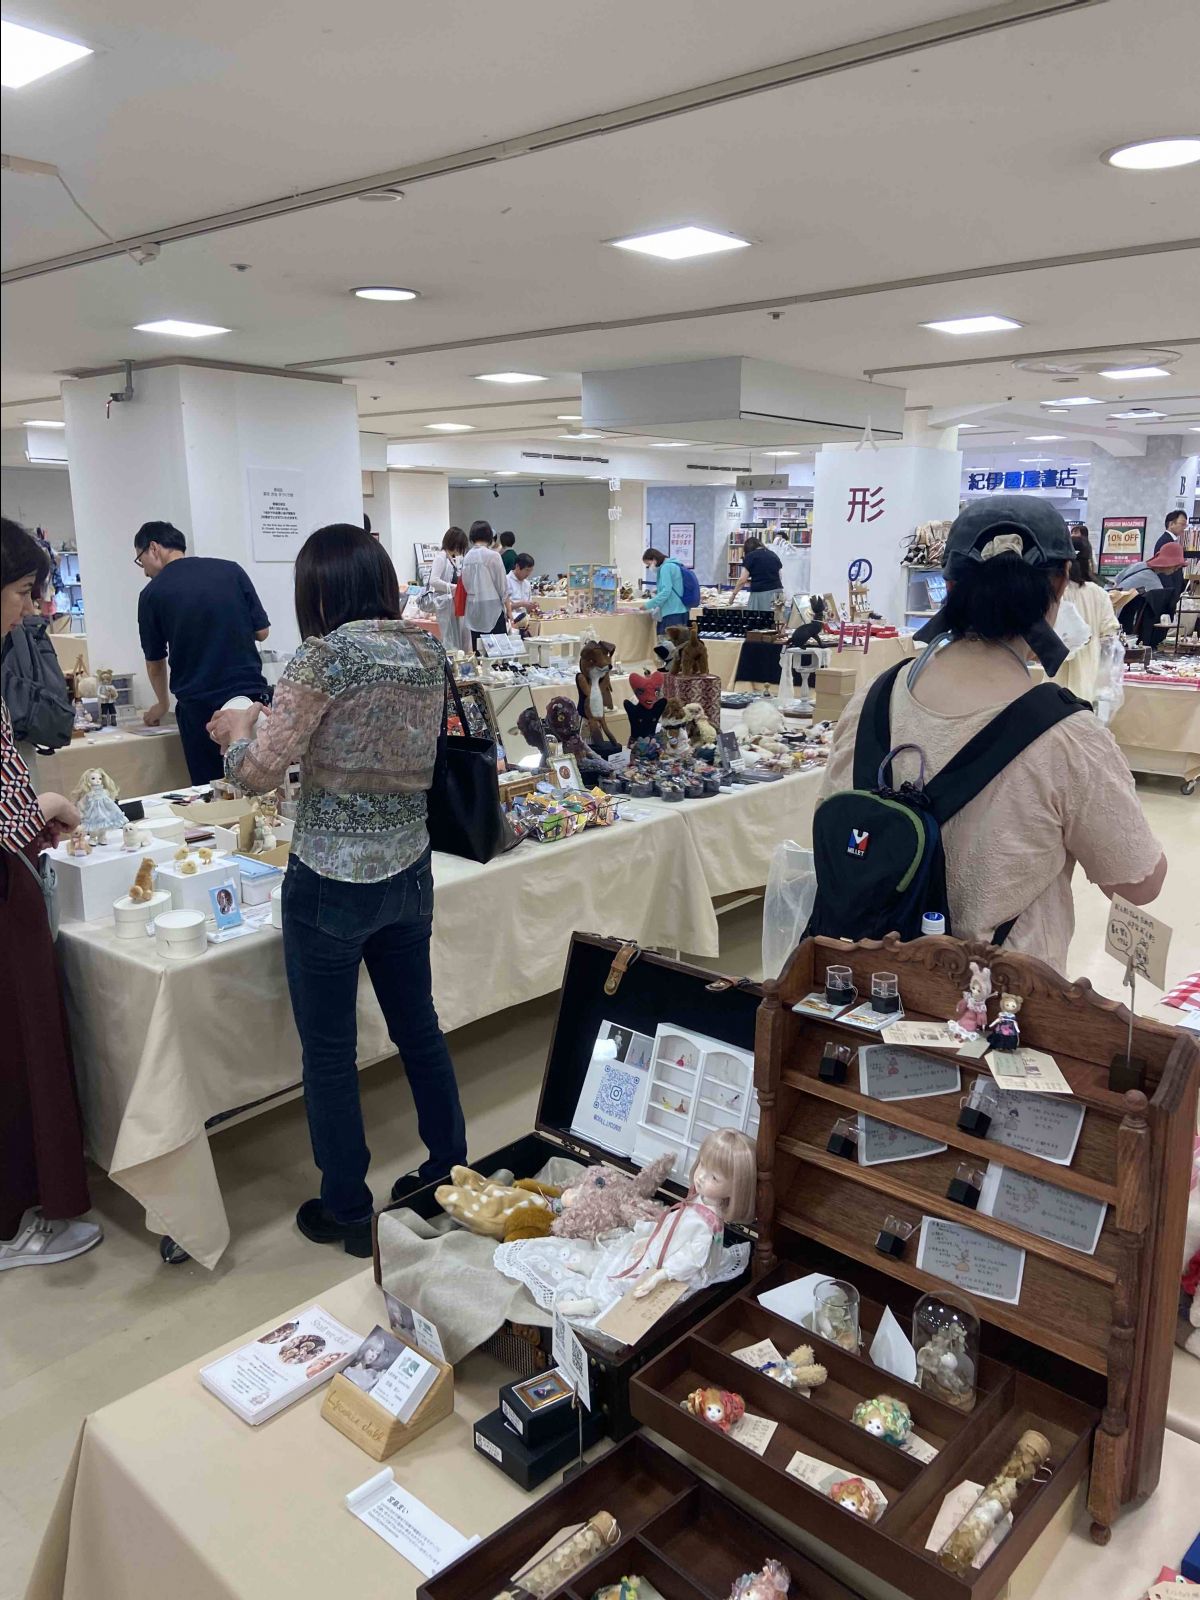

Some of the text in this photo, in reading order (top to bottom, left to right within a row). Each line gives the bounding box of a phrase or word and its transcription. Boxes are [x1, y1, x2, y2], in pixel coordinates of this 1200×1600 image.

[967, 467, 1078, 491] 紀伊國屋書店
[1179, 475, 1187, 496] B
[729, 491, 739, 508] A
[1107, 533, 1140, 542] 10% OFF
[847, 846, 865, 857] MILLET
